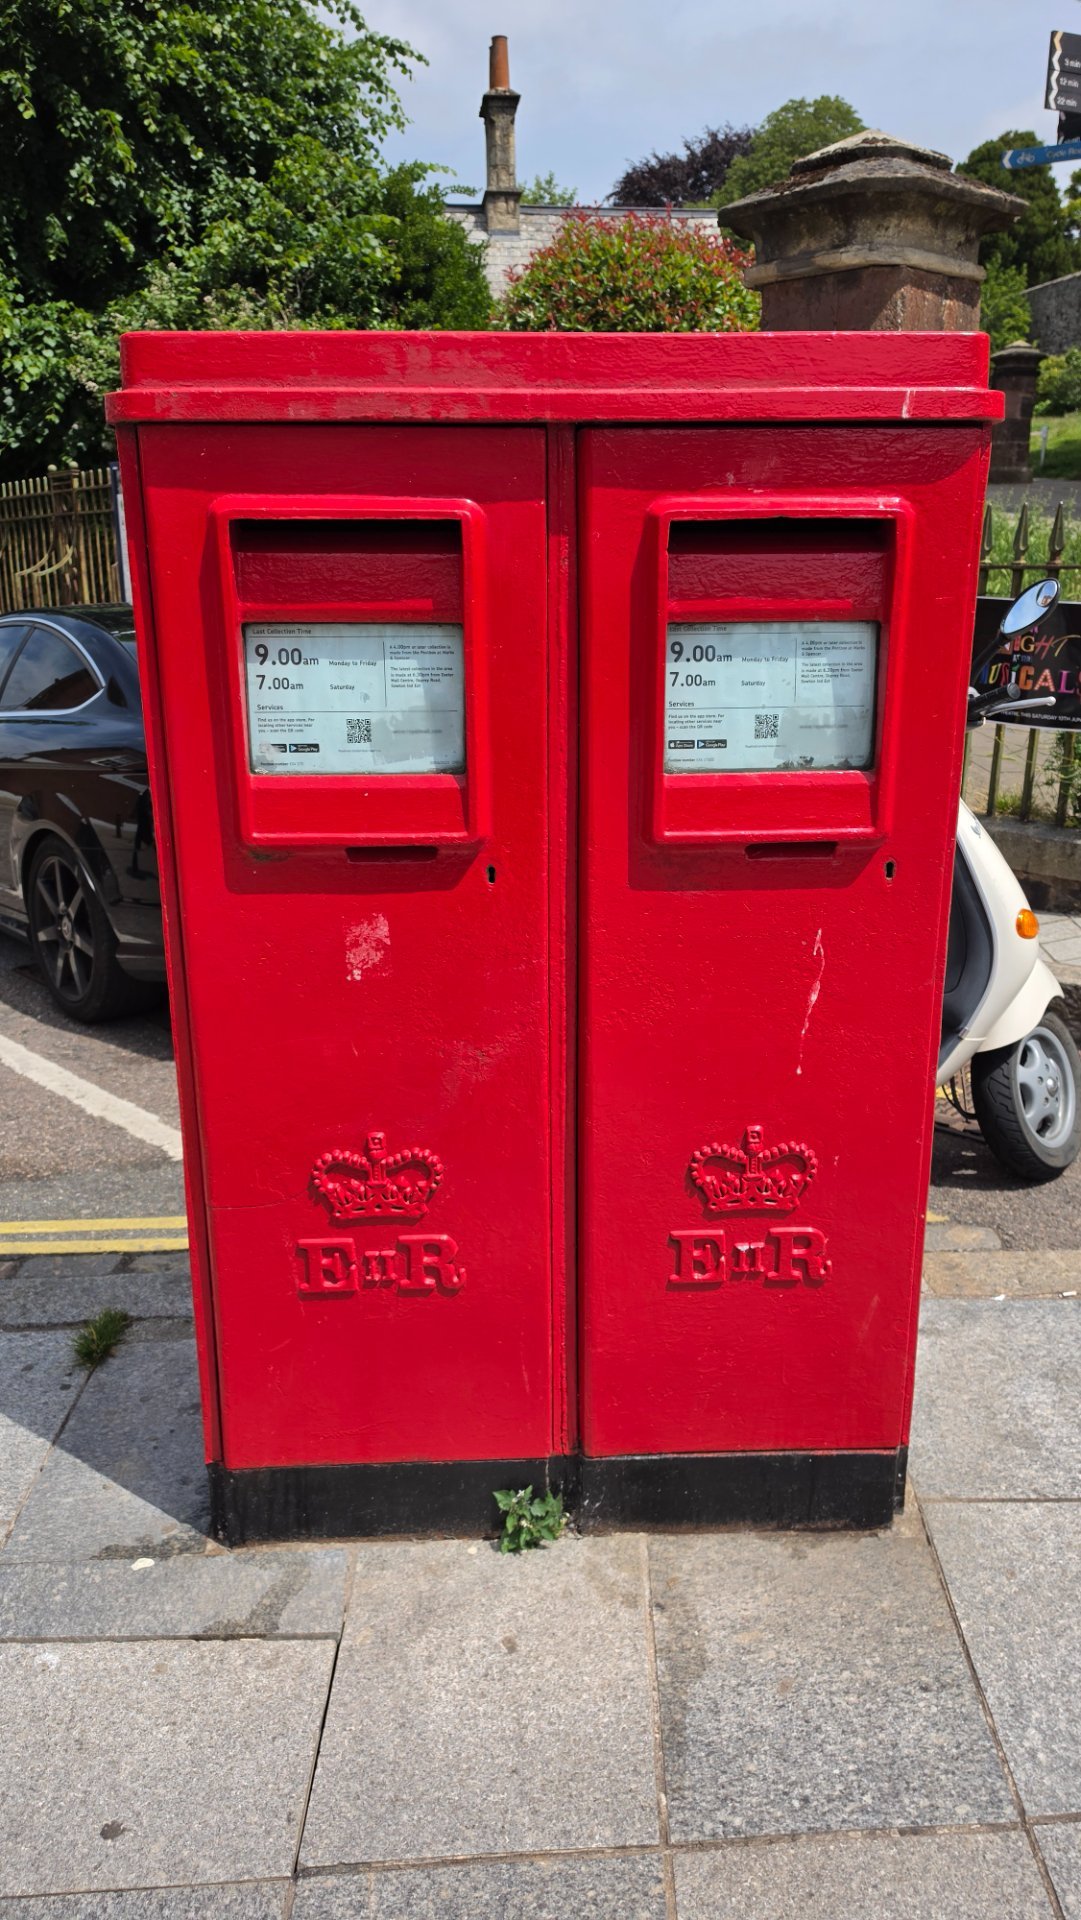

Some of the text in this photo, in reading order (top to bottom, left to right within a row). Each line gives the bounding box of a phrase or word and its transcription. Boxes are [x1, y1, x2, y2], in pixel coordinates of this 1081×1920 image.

[1067, 79, 1079, 88] min
[1065, 98, 1077, 107] min
[254, 643, 319, 665] 9.00am
[359, 659, 377, 667] Friday
[670, 641, 732, 663] 9.00am
[255, 674, 304, 690] 7.00am
[669, 672, 716, 687] 7.00am
